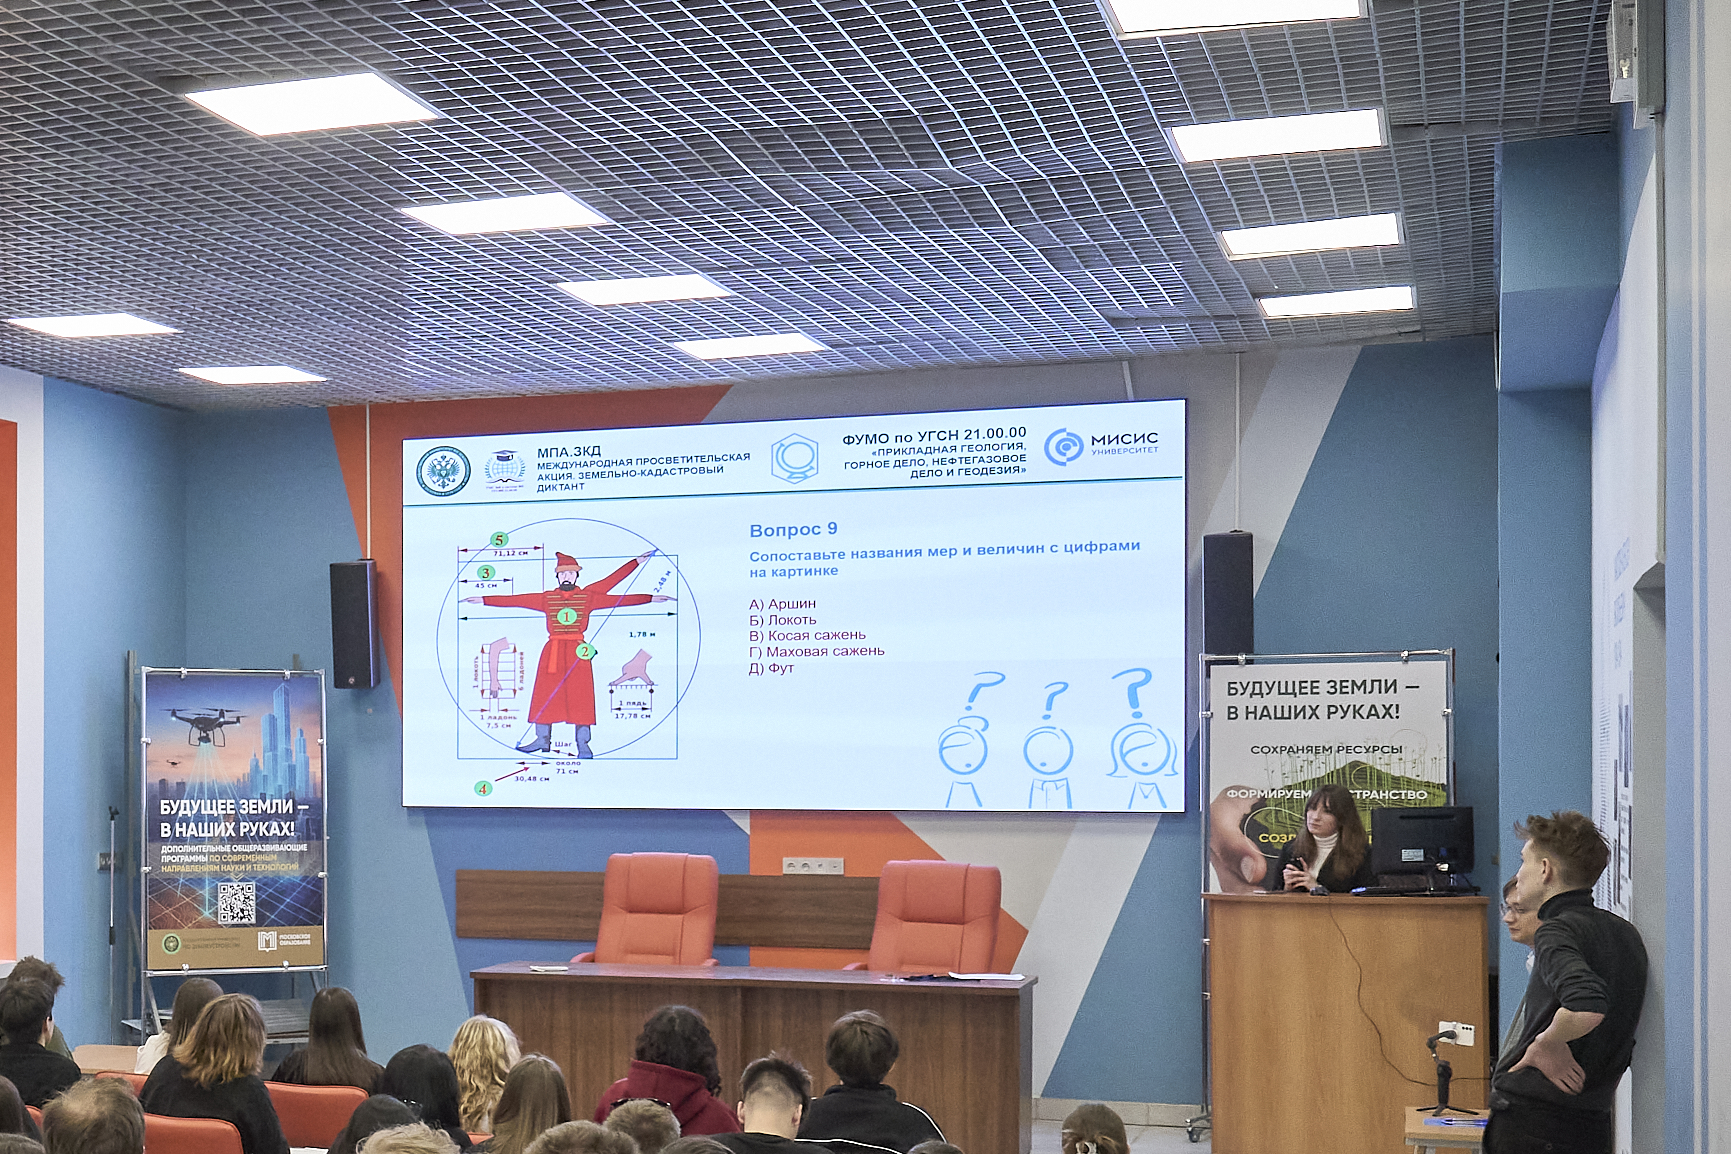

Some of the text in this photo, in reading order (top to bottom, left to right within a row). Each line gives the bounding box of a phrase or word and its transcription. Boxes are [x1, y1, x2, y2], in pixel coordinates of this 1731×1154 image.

[842, 427, 1027, 446] ФУМО по УГСН 21.00.00
[1091, 432, 1159, 446] МИСИС
[537, 446, 601, 459] МПА.ЗКД
[872, 442, 1027, 457] «ПРИКЛАДНАЯ ГЕОЛОГИЯ,
[1091, 447, 1159, 456] УНИВЕРСИТЕТ
[537, 453, 751, 470] МЕЖДУНАРОДНАЯ ПРОСВЕТИТЕЛЬСКАЯ
[844, 454, 1027, 470] ГОРНОЕ ДЕЛО, НЕФТЕГАЗОВОЕ
[537, 465, 724, 483] АКЦИЯ. ЗЕМЕЛЬНО-КАДАСТРОВЫЙ
[910, 465, 1027, 479] ДЕЛО И ГЕОДЕЗИЯ»
[537, 483, 585, 493] ДИКТАНТ
[750, 521, 838, 540] Вопрос 9
[496, 535, 504, 546] 5
[749, 541, 1141, 562] Сопоставьте названия мер и величин с цифрами
[482, 568, 490, 579] 3
[750, 566, 839, 579] на картинке
[749, 599, 816, 612] А) Аршин
[564, 611, 570, 622] 1
[749, 615, 817, 628] Б) Локоть
[749, 630, 866, 643] В) Косая сажень
[582, 647, 589, 656] 2
[749, 646, 885, 659] Г) Маховая сажень
[749, 662, 795, 676] Д) Фут
[1227, 680, 1320, 698] БУДУЩЕЕ
[1326, 679, 1398, 696] ЗЕМЛИ
[1227, 703, 1400, 720] В НАШИХ РУКАХ!
[1250, 745, 1403, 755] СОХРАНЯЕМ РЕСУРСЫ
[479, 784, 487, 795] 4
[1226, 789, 1312, 800] ФОРМИРУЕМ
[160, 799, 236, 817] БУДУЩЕЕ
[239, 799, 293, 814] ЗЕМЛИ
[160, 821, 295, 837] В НАШИХ РУКАХ!
[161, 843, 308, 854] ДОПОЛНИТЕЛЬНЫЕ ОБЩЕРАЗВИВАЮЩИЕ
[161, 854, 208, 863] ПРОГРАММЫ
[209, 854, 220, 862] ПО
[161, 865, 220, 873] НАПРАВЛЕНИЯМ
[221, 864, 245, 872] НАУКИ
[246, 864, 252, 872] И
